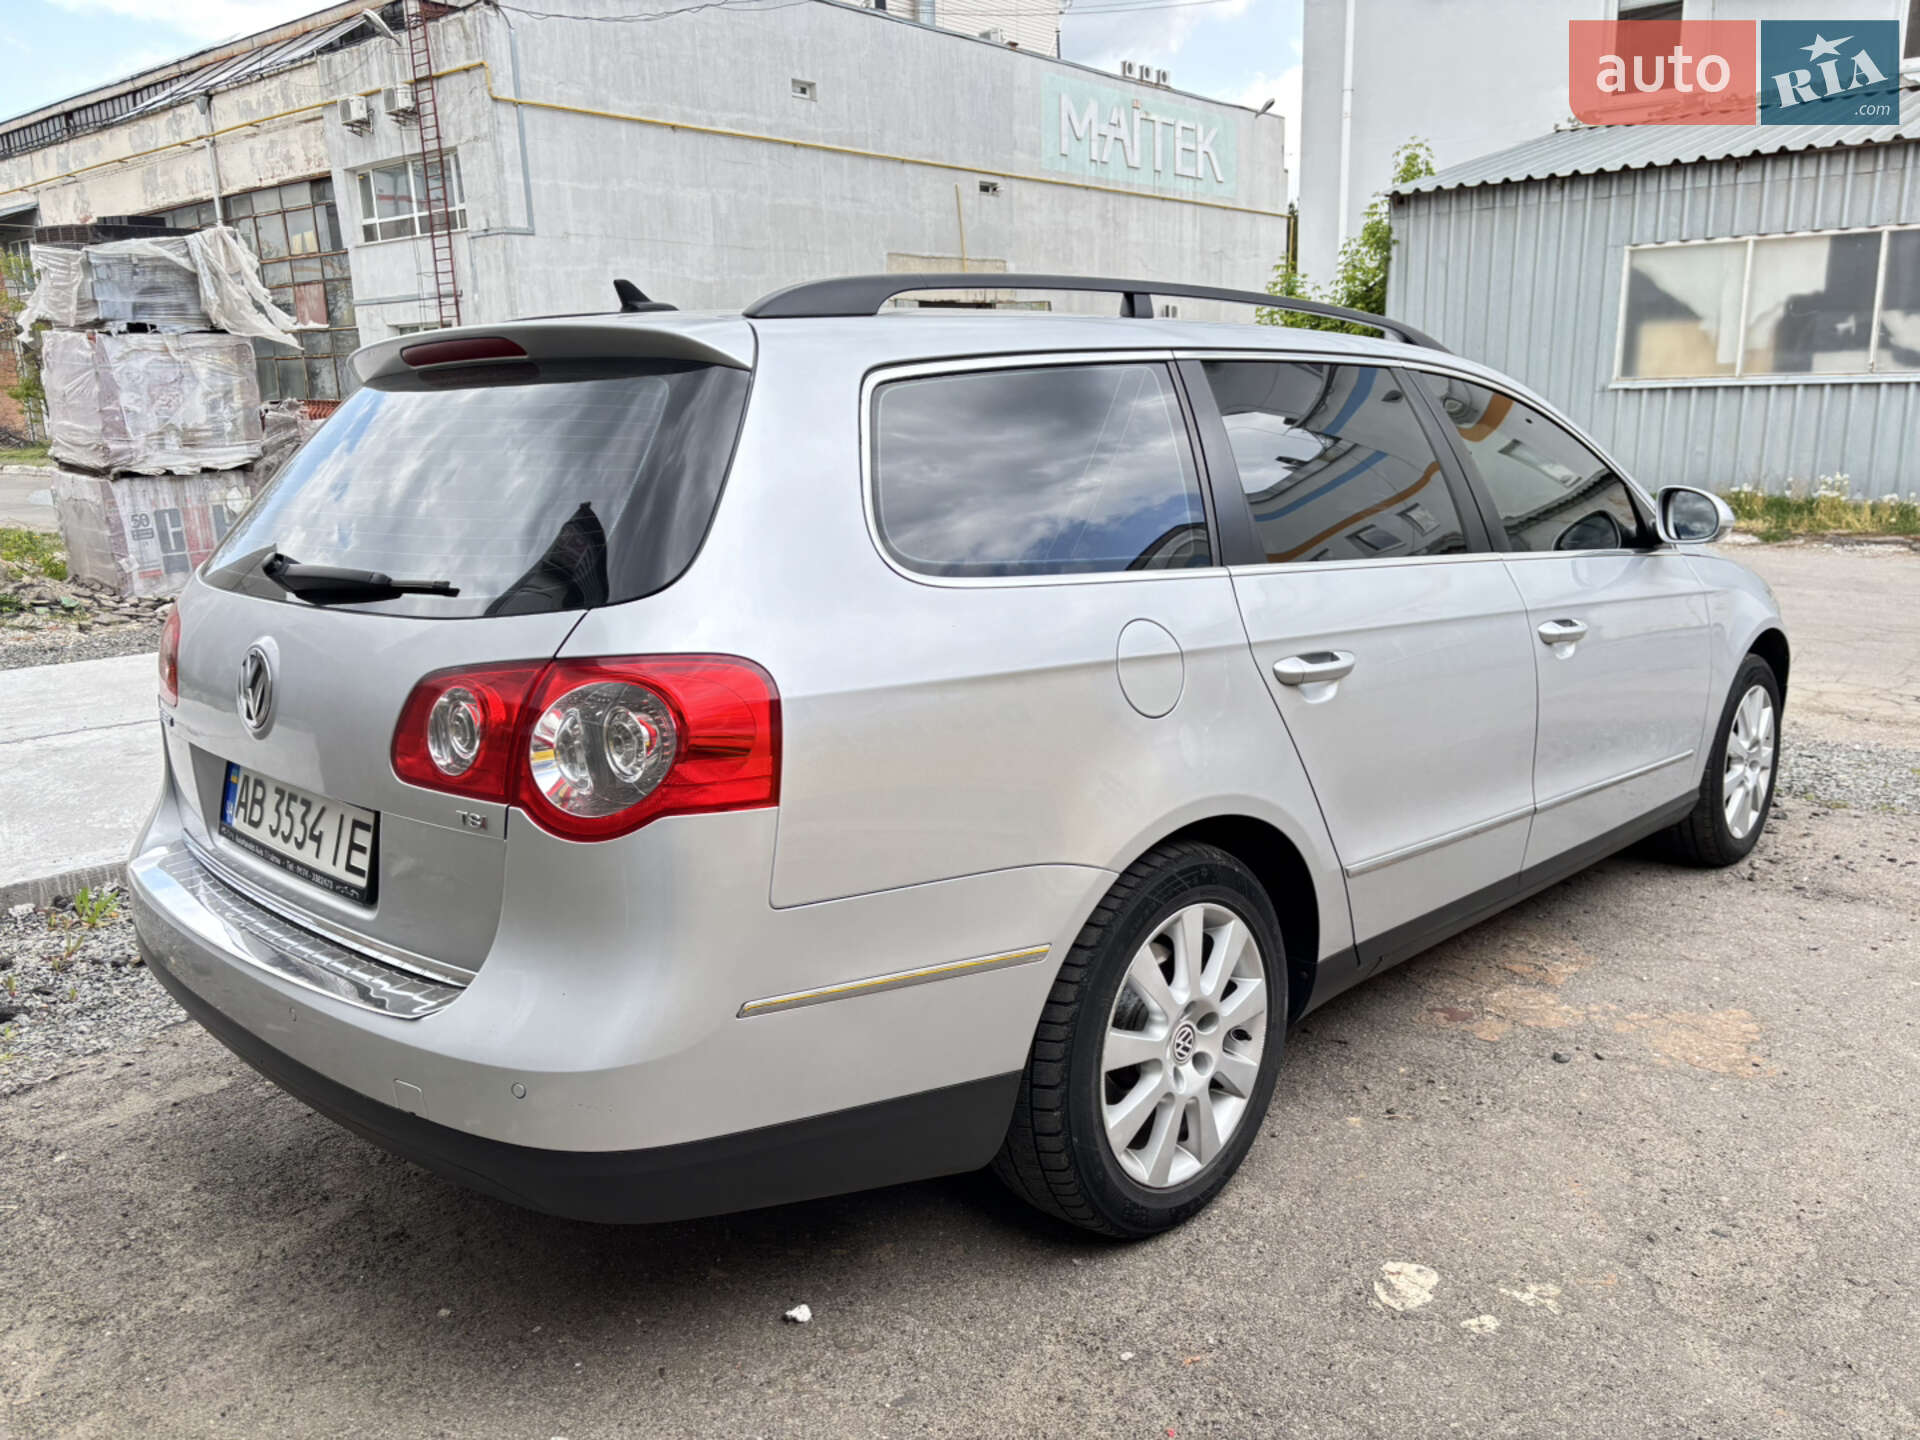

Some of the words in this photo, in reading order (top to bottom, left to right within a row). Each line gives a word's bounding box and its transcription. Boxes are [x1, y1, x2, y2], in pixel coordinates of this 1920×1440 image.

[235, 774, 266, 830] AB
[268, 786, 327, 860] 3534
[332, 812, 372, 879] IE
